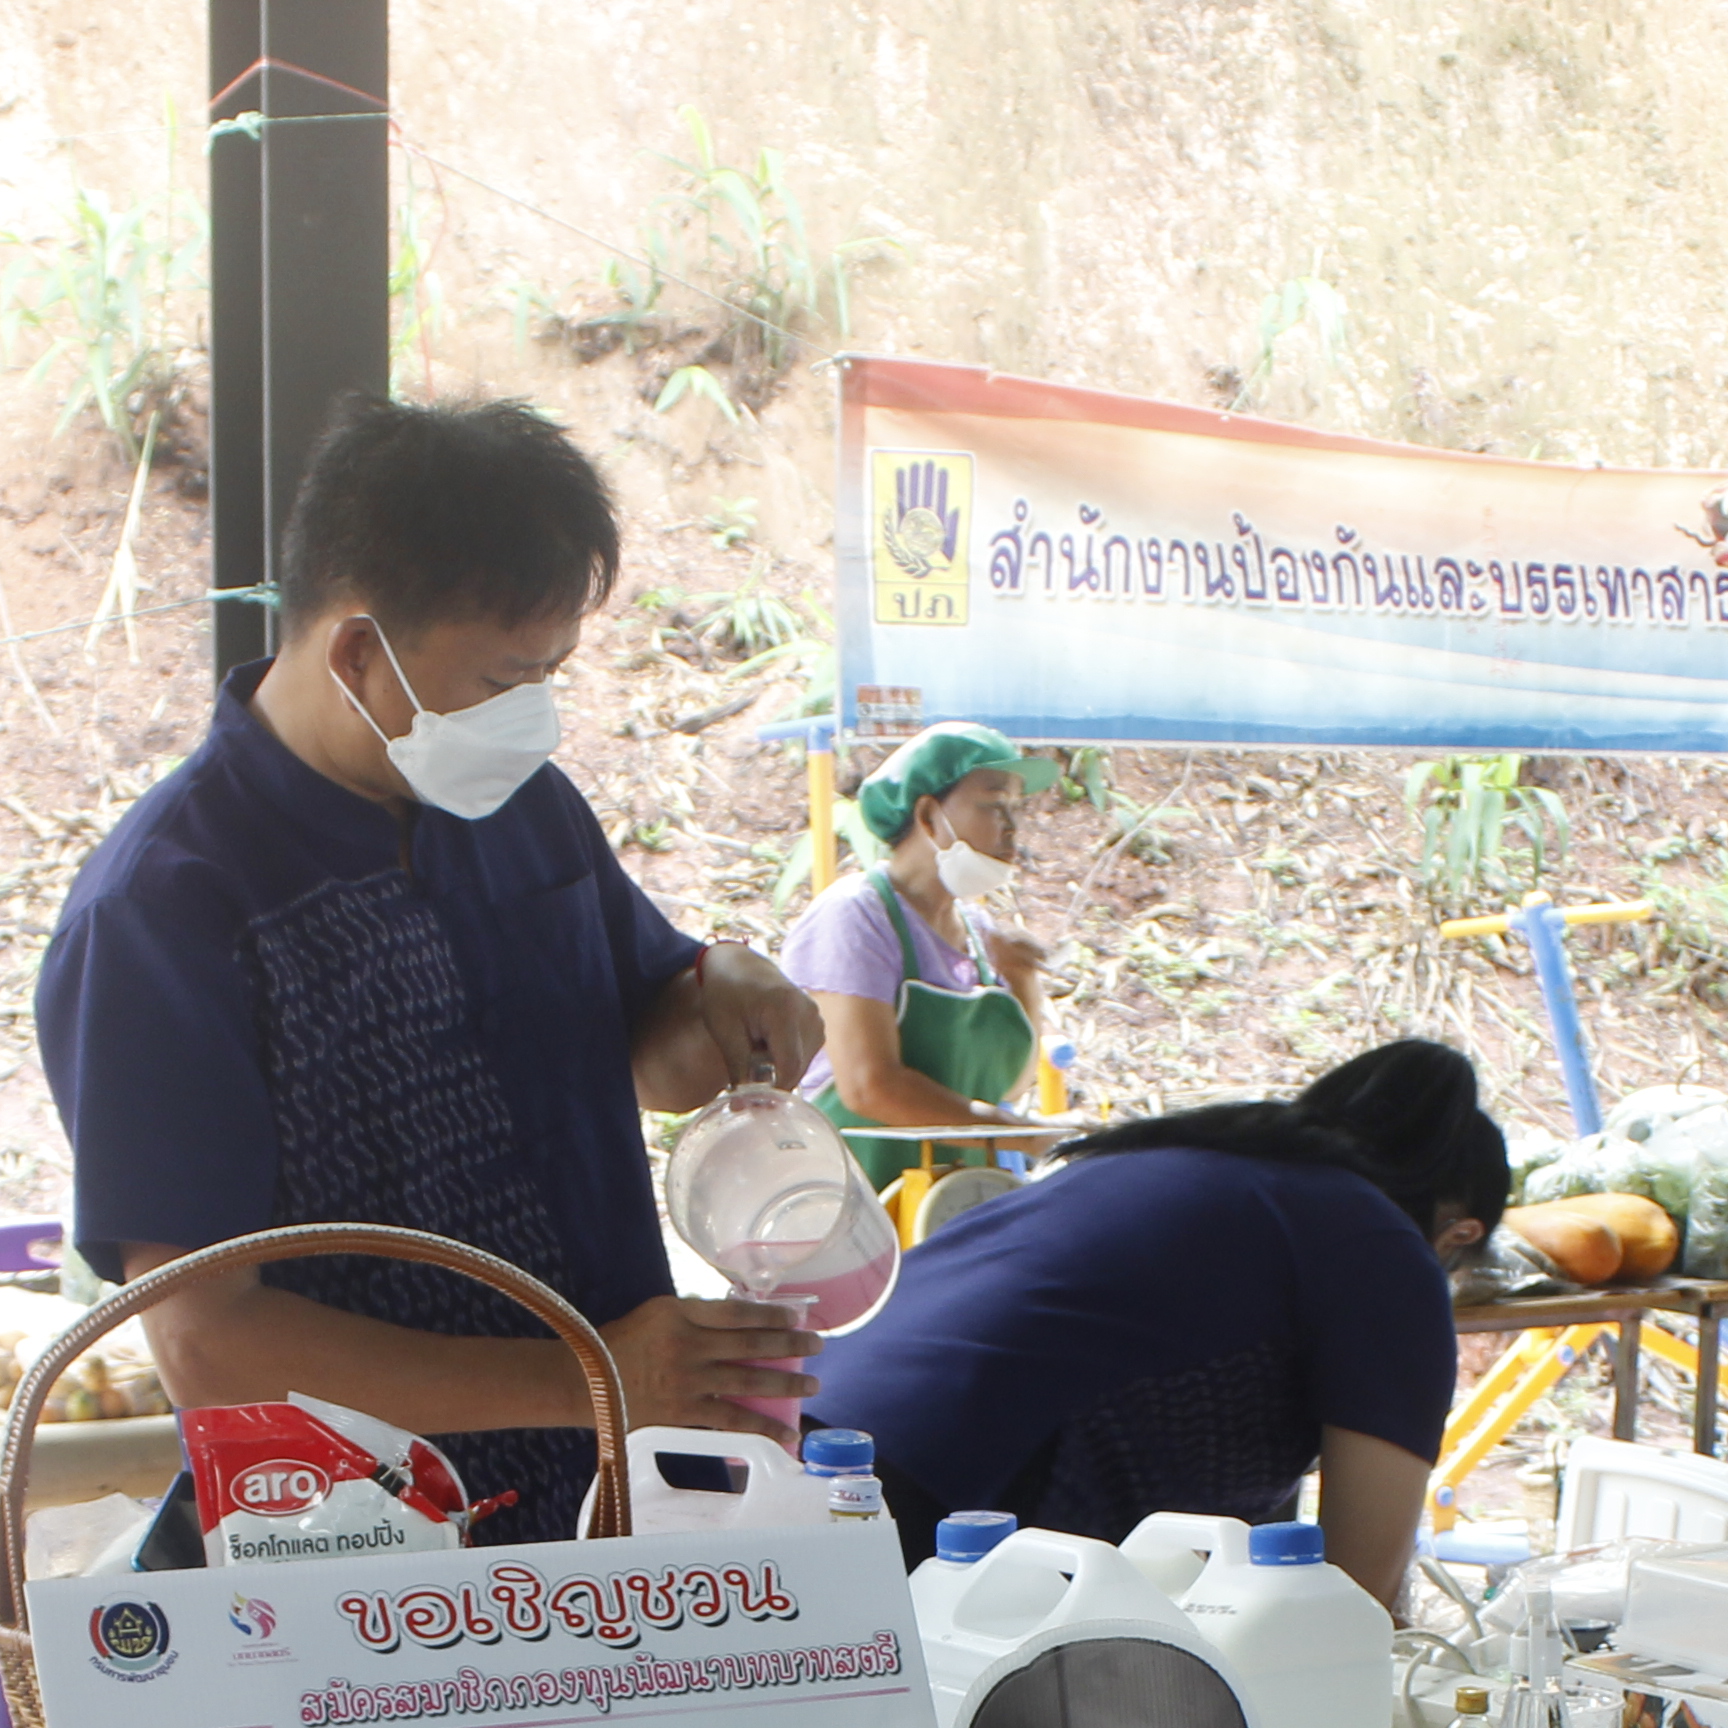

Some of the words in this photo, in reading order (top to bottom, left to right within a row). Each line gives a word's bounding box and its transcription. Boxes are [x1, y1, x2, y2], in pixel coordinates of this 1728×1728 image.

[242, 1472, 318, 1504] aro
[337, 1518, 405, 1550] ทอปปิ้ง
[339, 1560, 796, 1643] ขอเชิญชวน
[299, 1633, 901, 1724] สมัครสมาชิกกองทุนพัฒนาบทบาทสตรี
